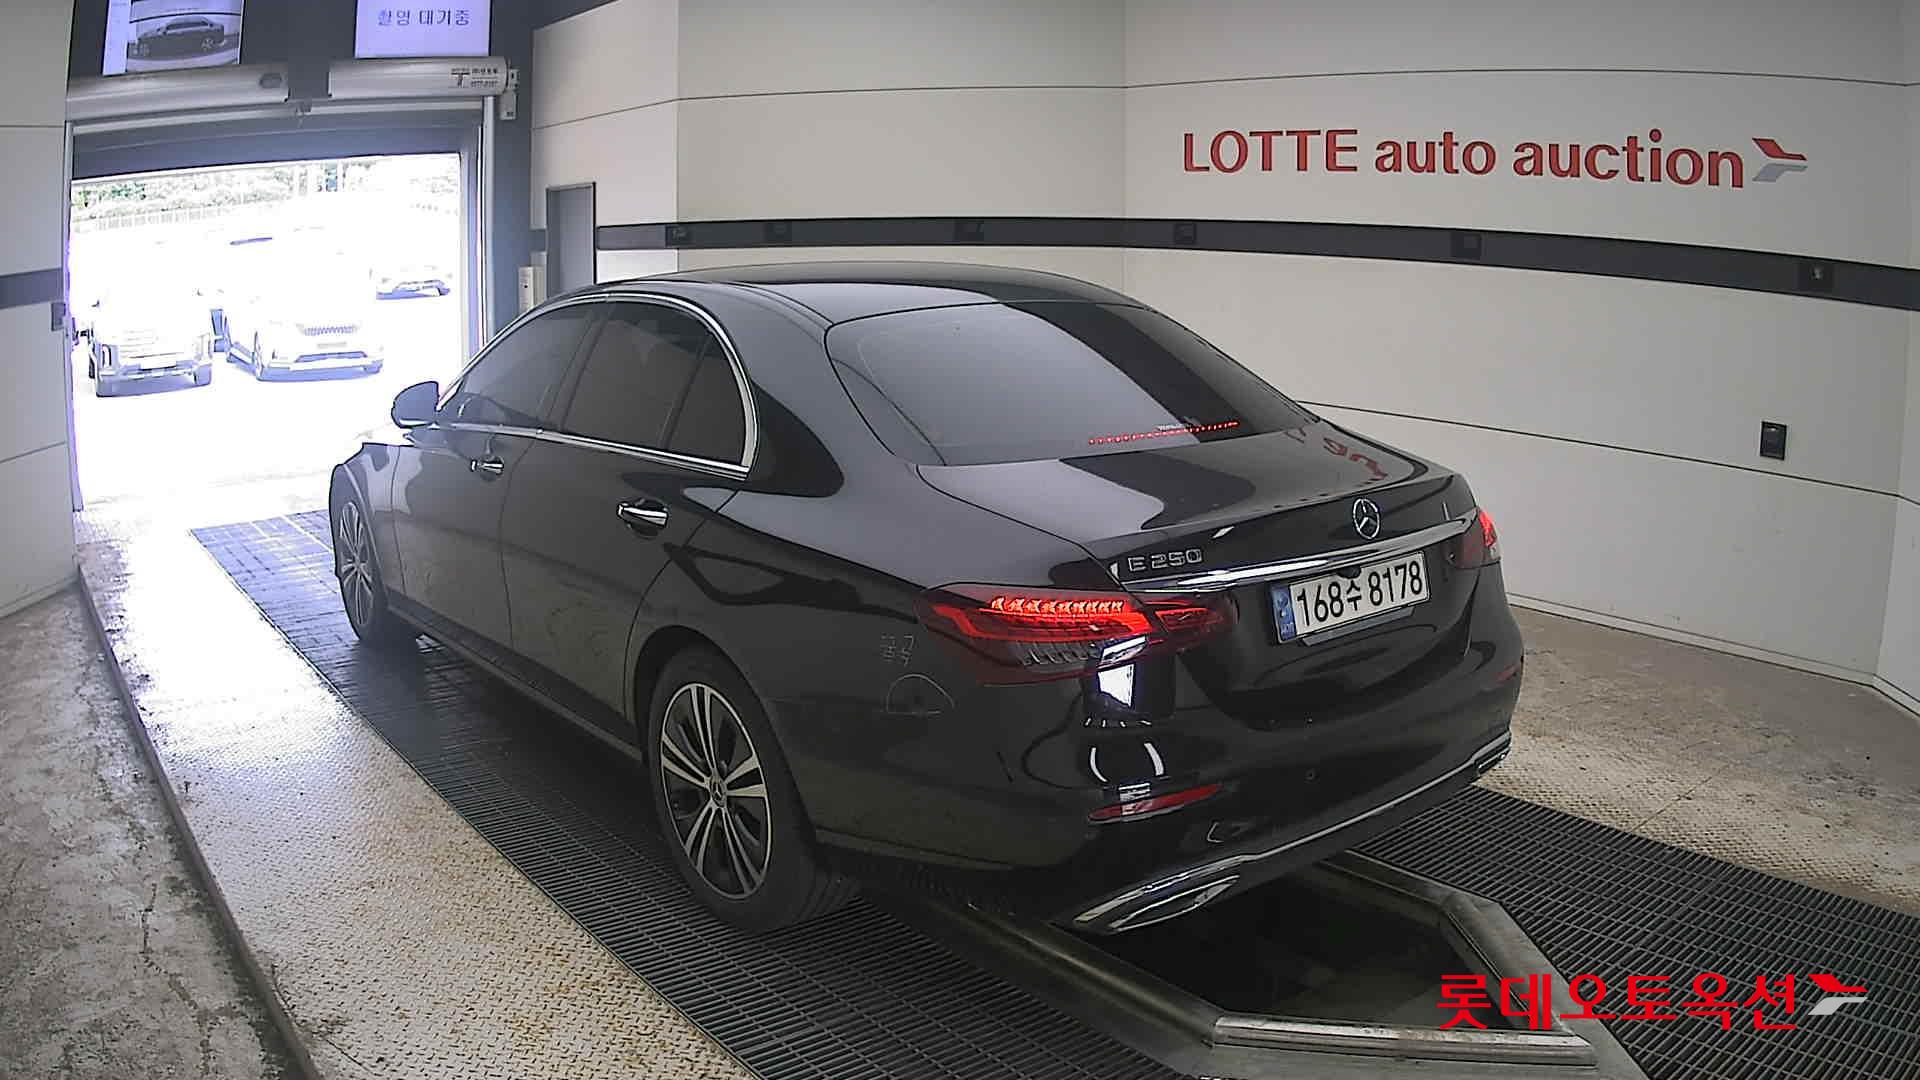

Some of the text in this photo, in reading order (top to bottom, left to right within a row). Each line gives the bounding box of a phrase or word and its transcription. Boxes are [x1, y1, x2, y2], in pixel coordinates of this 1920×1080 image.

[418, 8, 470, 26] 대기중
[1183, 128, 1745, 189] LOTTE auto auction
[1127, 548, 1204, 573] E 250
[1297, 560, 1423, 627] 168수 8178
